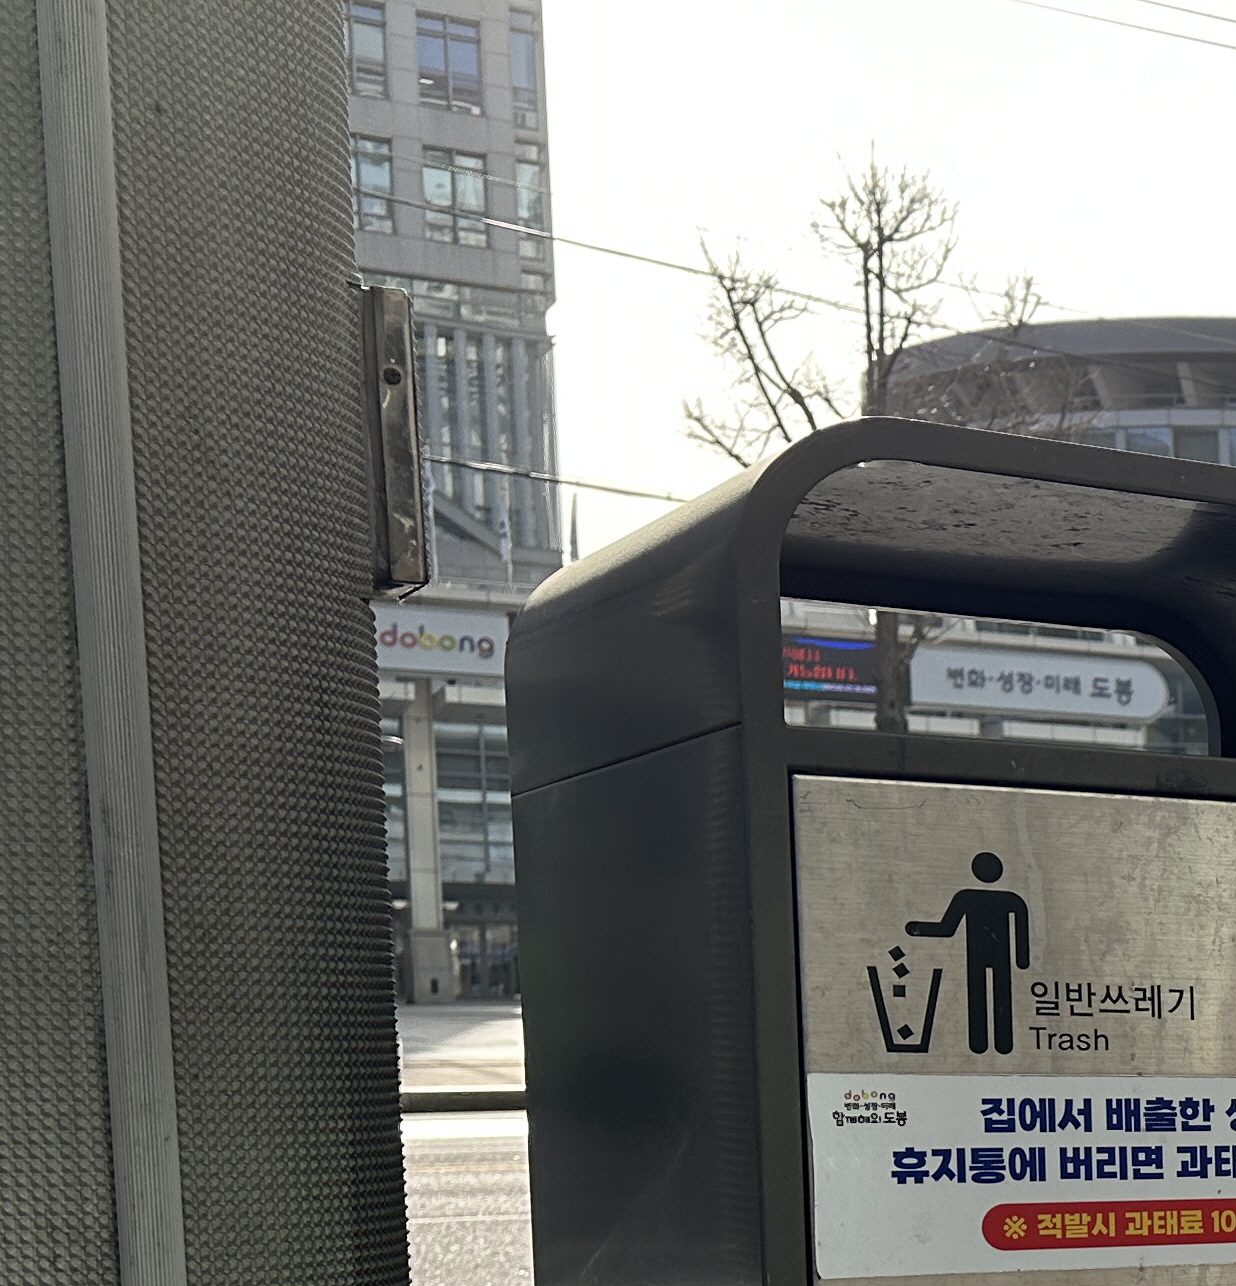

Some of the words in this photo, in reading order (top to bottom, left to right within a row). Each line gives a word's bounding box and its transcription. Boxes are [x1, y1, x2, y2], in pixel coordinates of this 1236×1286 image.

[380, 622, 495, 659] dobong
[1089, 676, 1134, 706] 도봉
[1029, 980, 1196, 1020] 일반쓰레기
[1029, 1026, 1110, 1051] Trash
[844, 1090, 896, 1101] dobong
[883, 1111, 907, 1126] 도봉
[980, 1097, 1093, 1133] 집에서
[1106, 1096, 1215, 1132] 배출한
[891, 1147, 1046, 1184] 휴지통에
[1059, 1145, 1164, 1181] 버리면
[1037, 1212, 1116, 1239] 적발시
[1125, 1209, 1204, 1237] 과태료
